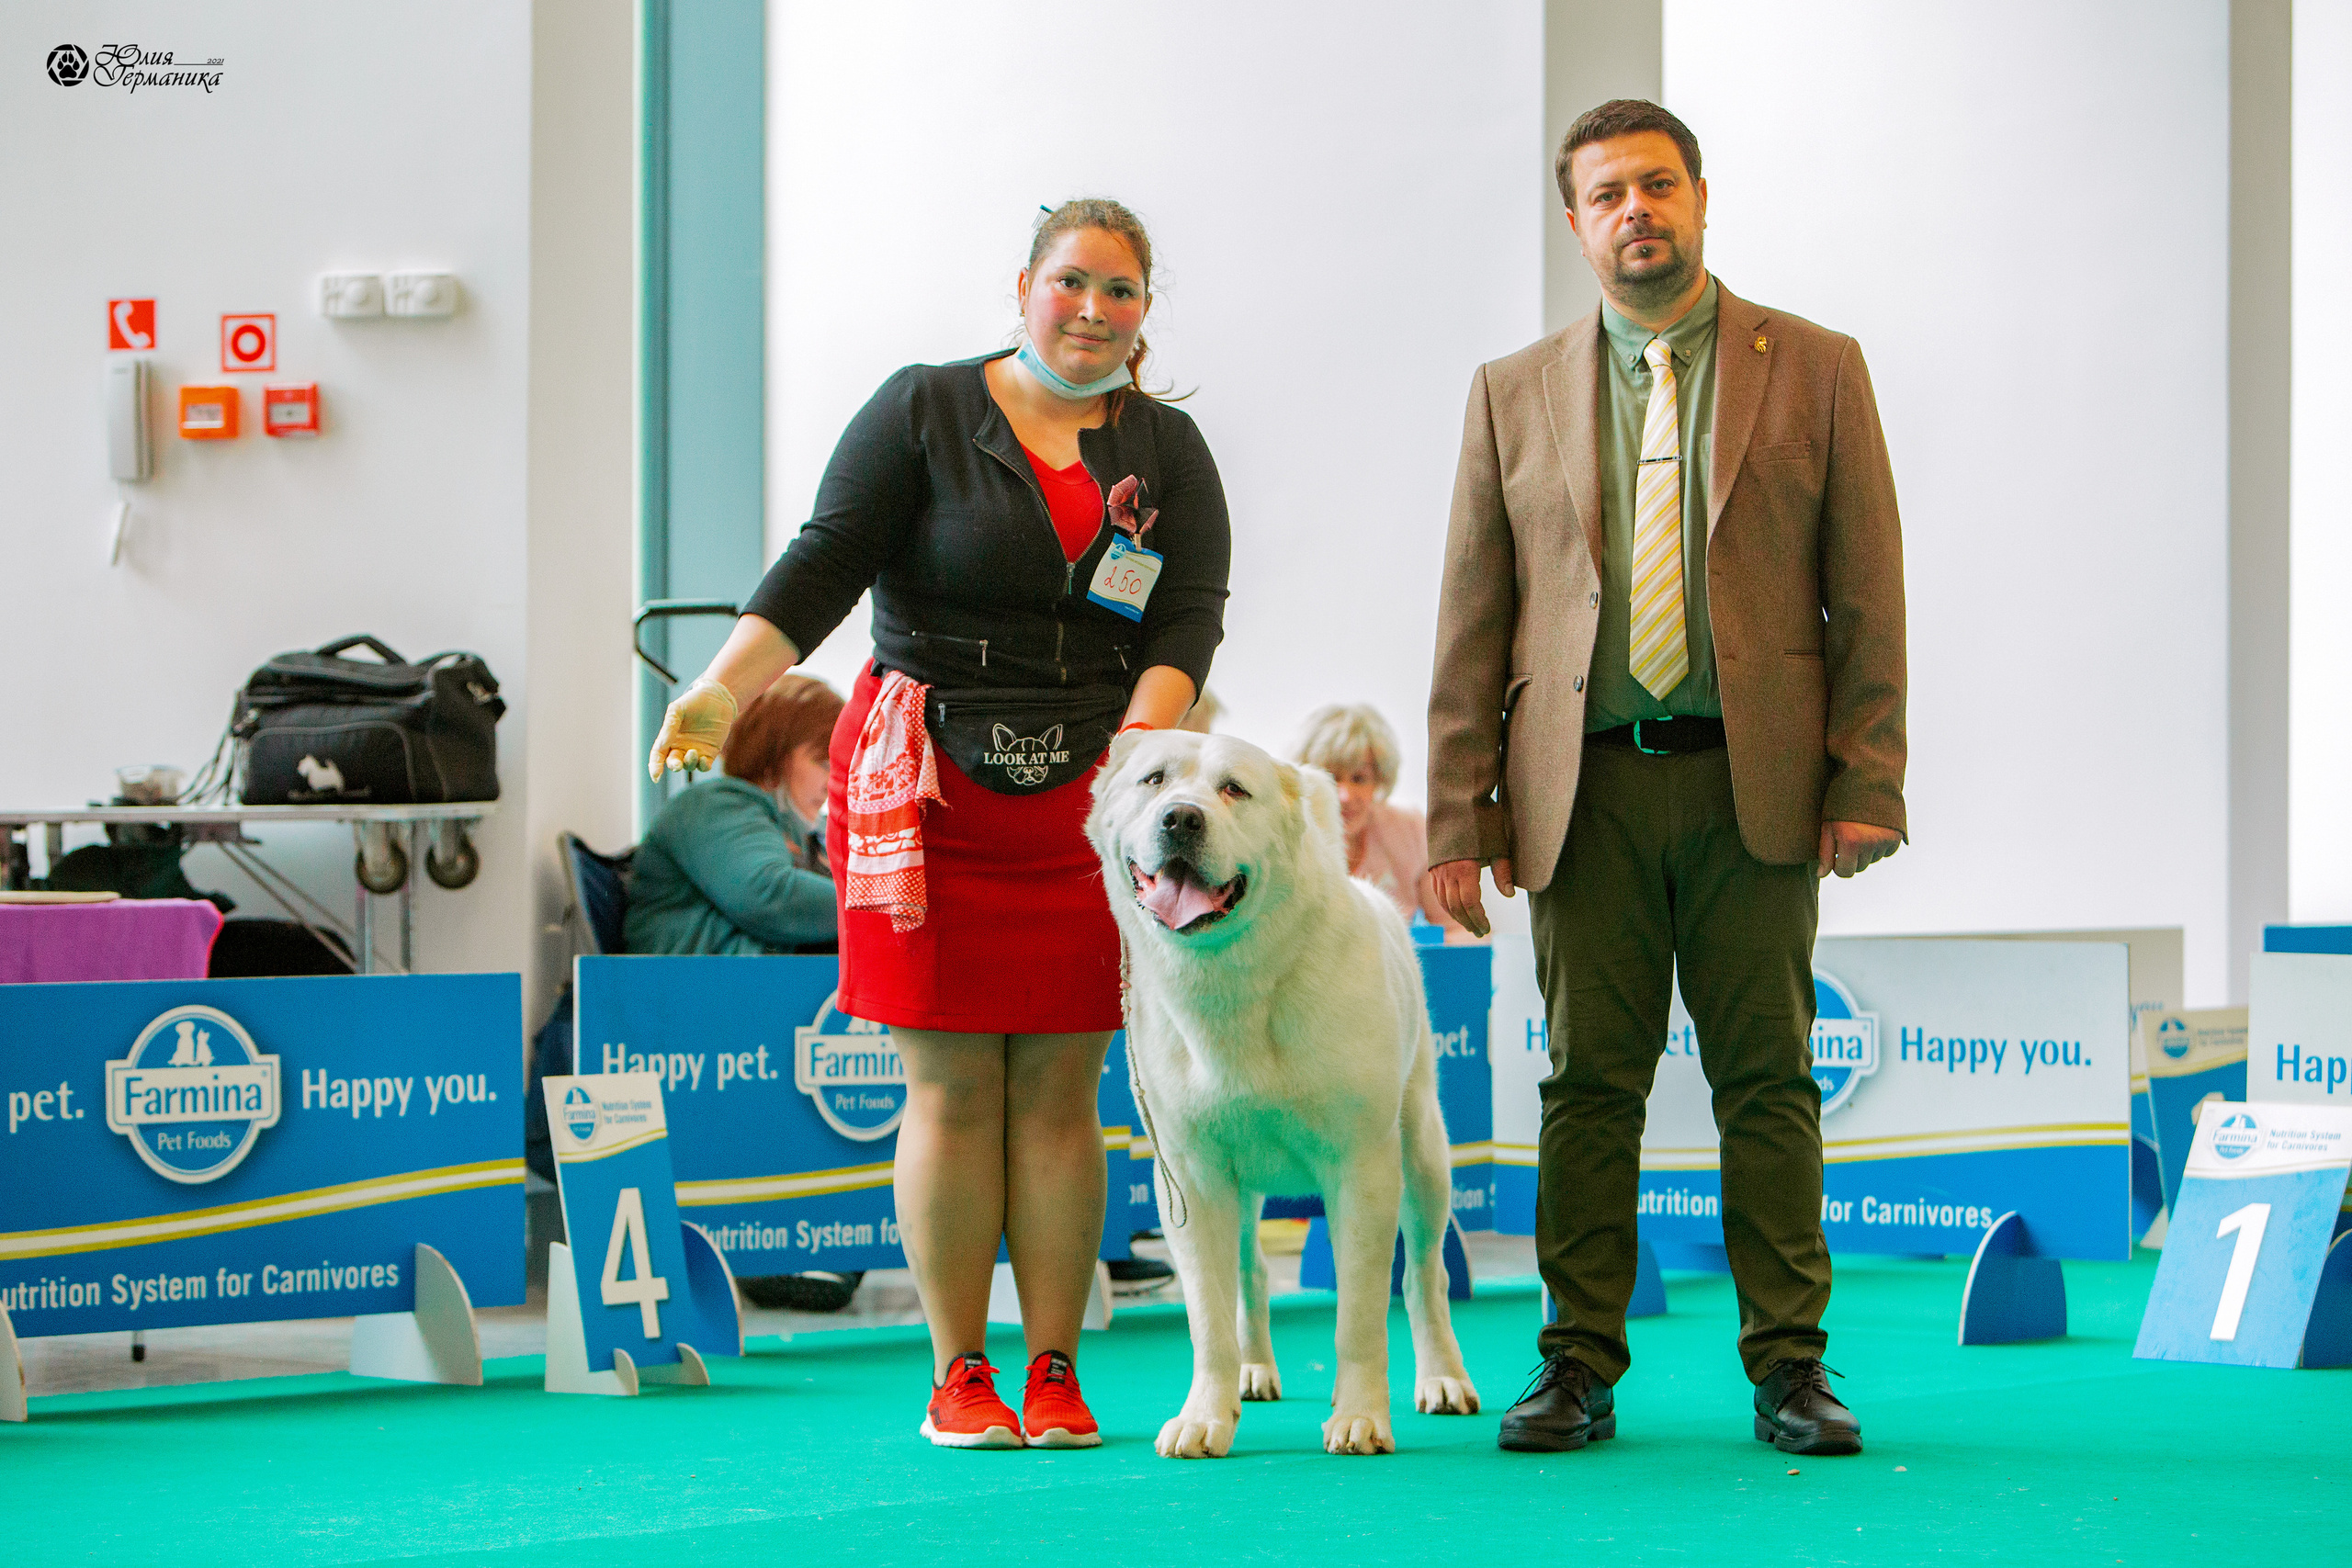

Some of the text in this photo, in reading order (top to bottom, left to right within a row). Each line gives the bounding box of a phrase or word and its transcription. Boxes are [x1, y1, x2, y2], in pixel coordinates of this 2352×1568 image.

[1103, 565, 1142, 595] 250
[983, 750, 1070, 765] LOOK AT ME
[602, 1042, 779, 1092] Happy pet.
[809, 1041, 904, 1077] Farmin
[1900, 1025, 2007, 1075] Happy
[2020, 1039, 2092, 1075] you.
[2276, 1043, 2352, 1096] Hap
[8, 1080, 85, 1134] pet.
[124, 1072, 263, 1116] Farmina
[301, 1067, 498, 1120] Happy you.
[835, 1092, 896, 1111] Pet Foods
[157, 1130, 232, 1151] Pet Foods
[2212, 1129, 2258, 1144] Farmina
[2267, 1140, 2328, 1152] for Carnivores
[2269, 1129, 2342, 1142] Nutrition System
[1636, 1186, 1994, 1229] utrition for Carnivores
[700, 1216, 900, 1254] utrition System fo
[600, 1187, 670, 1339] 4
[2209, 1201, 2272, 1342] 1
[2, 1259, 400, 1311] utrition System for Carnivores
